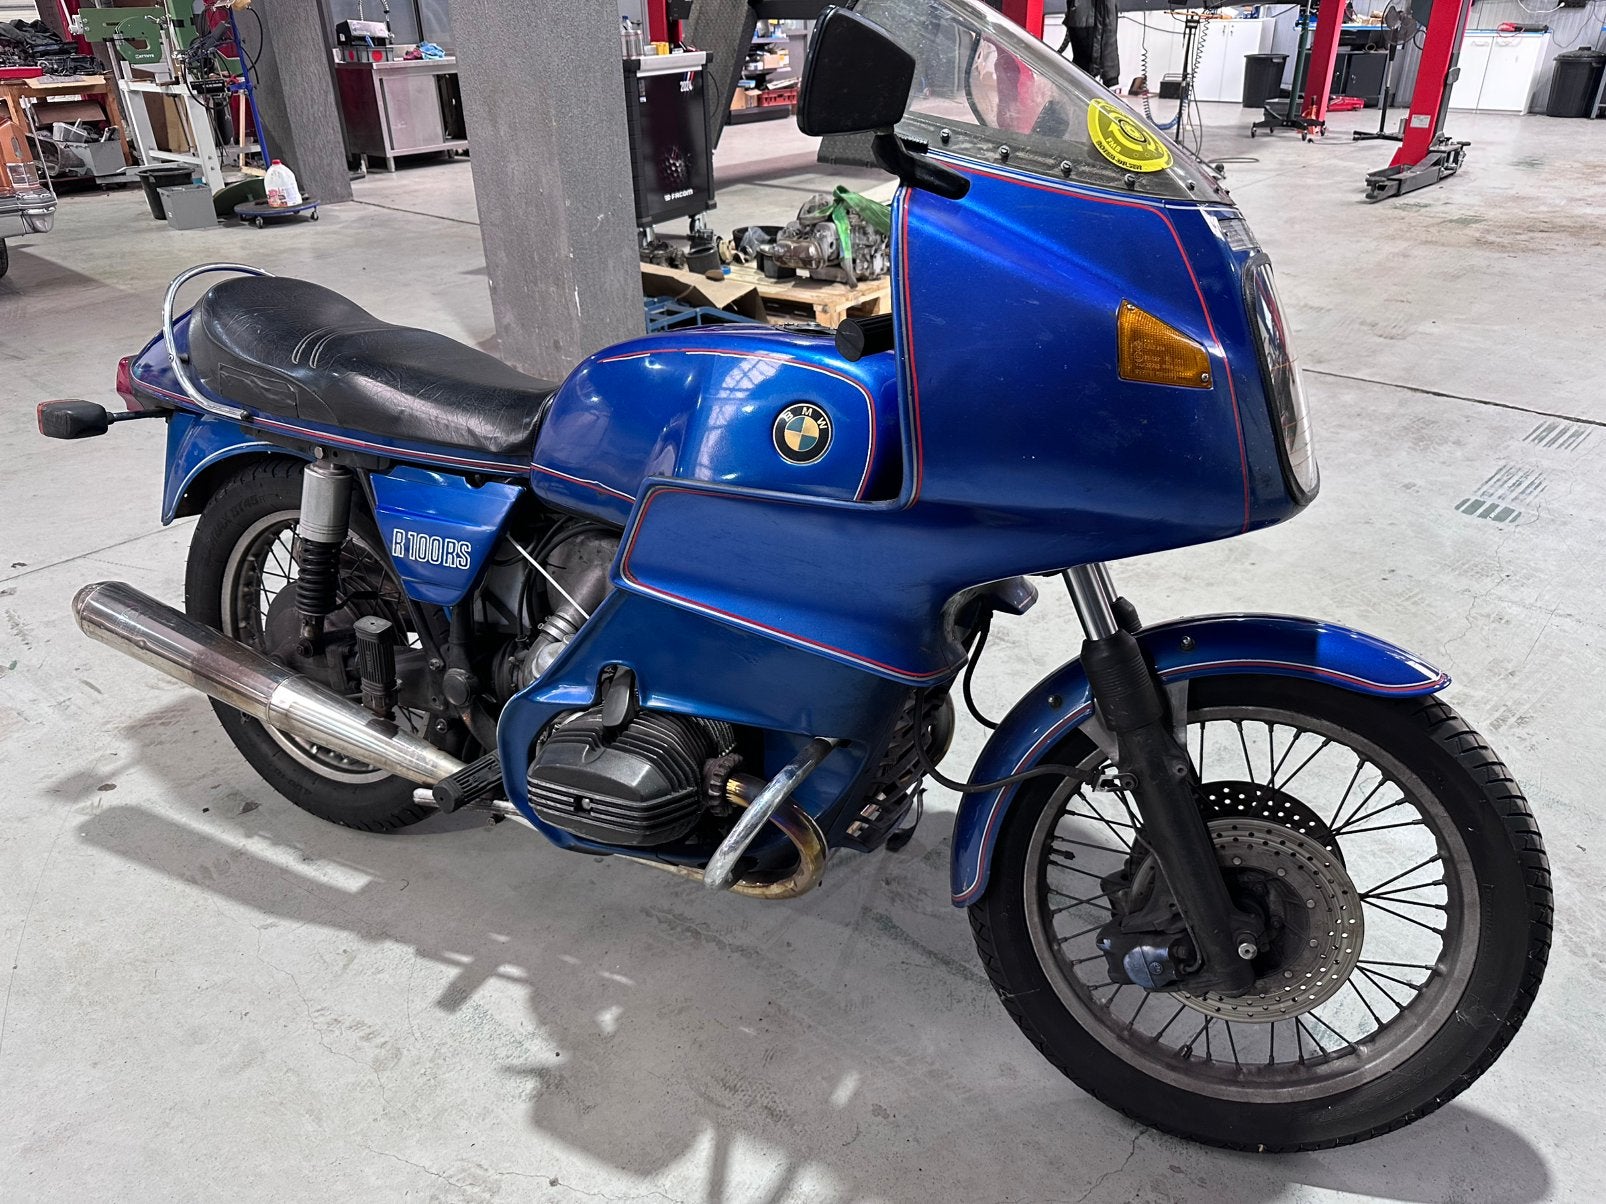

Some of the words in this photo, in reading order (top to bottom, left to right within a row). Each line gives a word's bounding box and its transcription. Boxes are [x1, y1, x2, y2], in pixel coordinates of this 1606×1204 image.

[1106, 138, 1122, 152] FMB
[671, 188, 693, 200] FACOM
[782, 406, 828, 430] BMW
